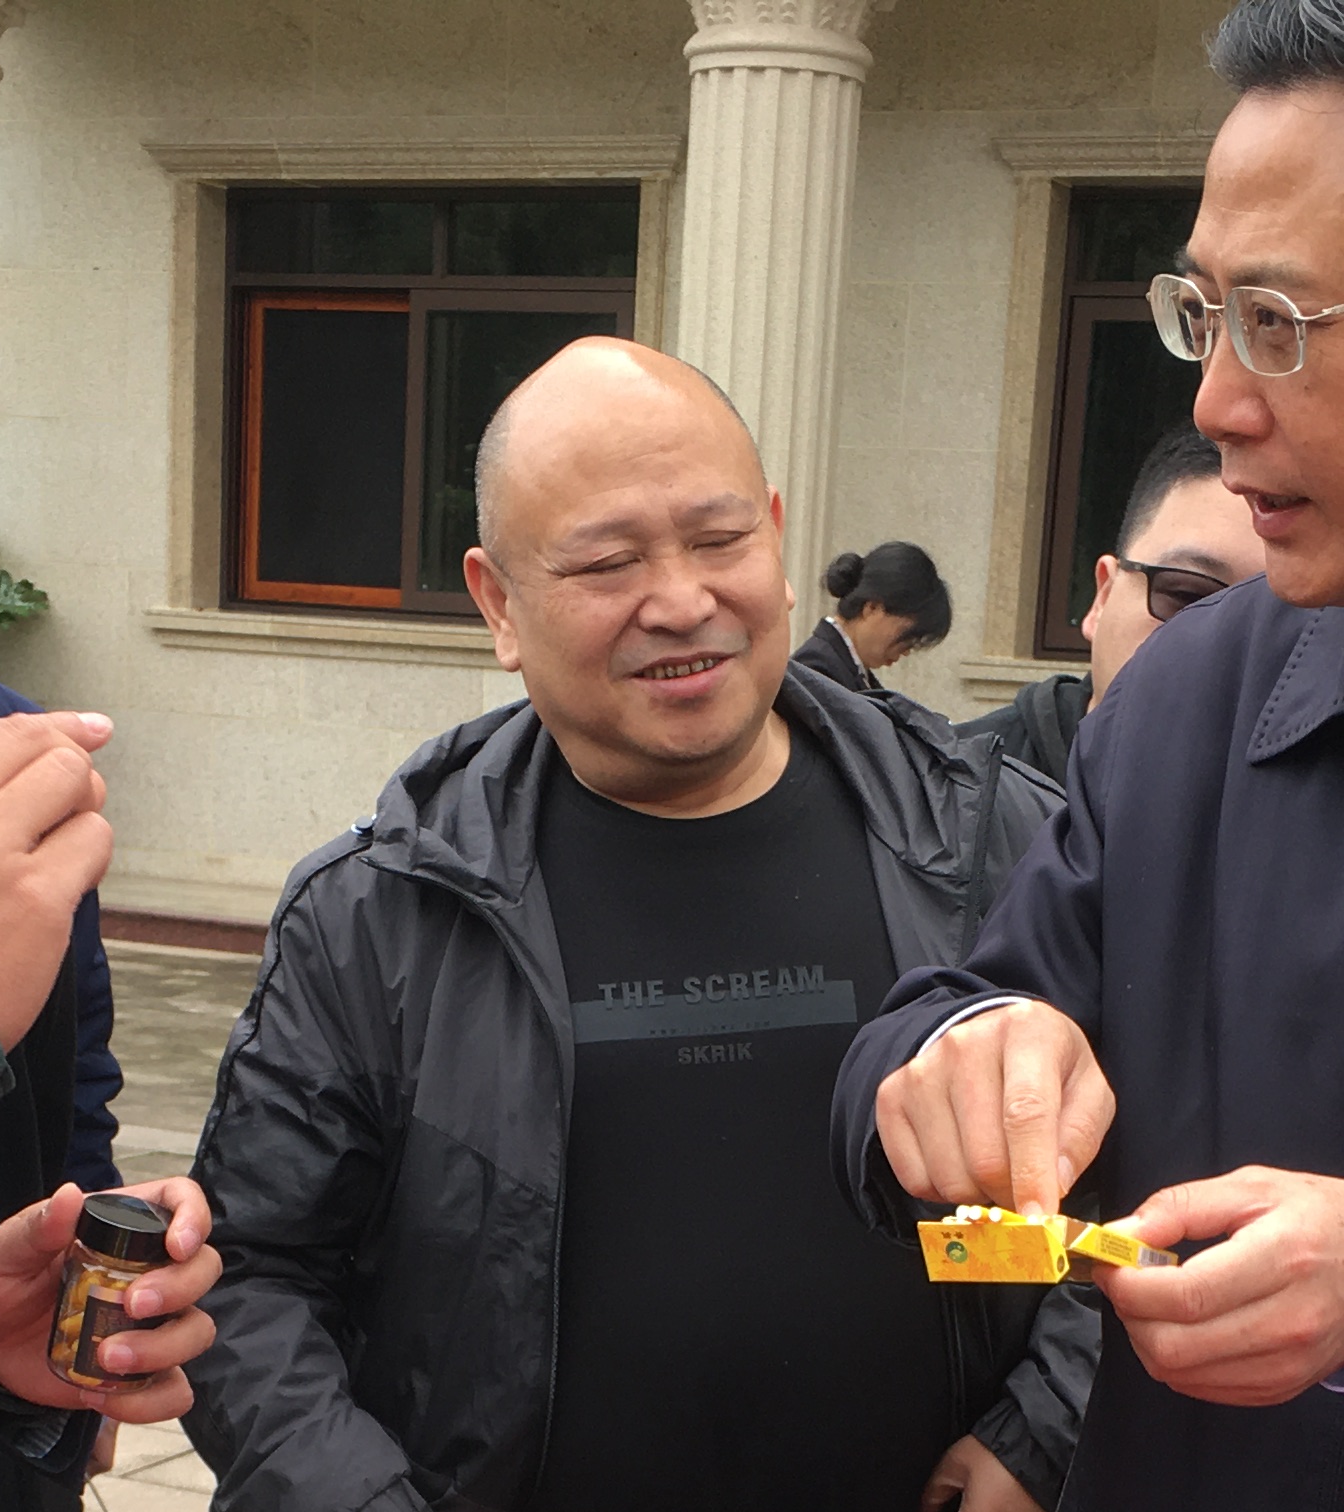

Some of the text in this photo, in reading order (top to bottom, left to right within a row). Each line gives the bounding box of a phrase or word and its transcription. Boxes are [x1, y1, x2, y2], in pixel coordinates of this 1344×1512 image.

[598, 964, 826, 1010] THE SCREAM
[678, 1042, 753, 1065] SKRIK
